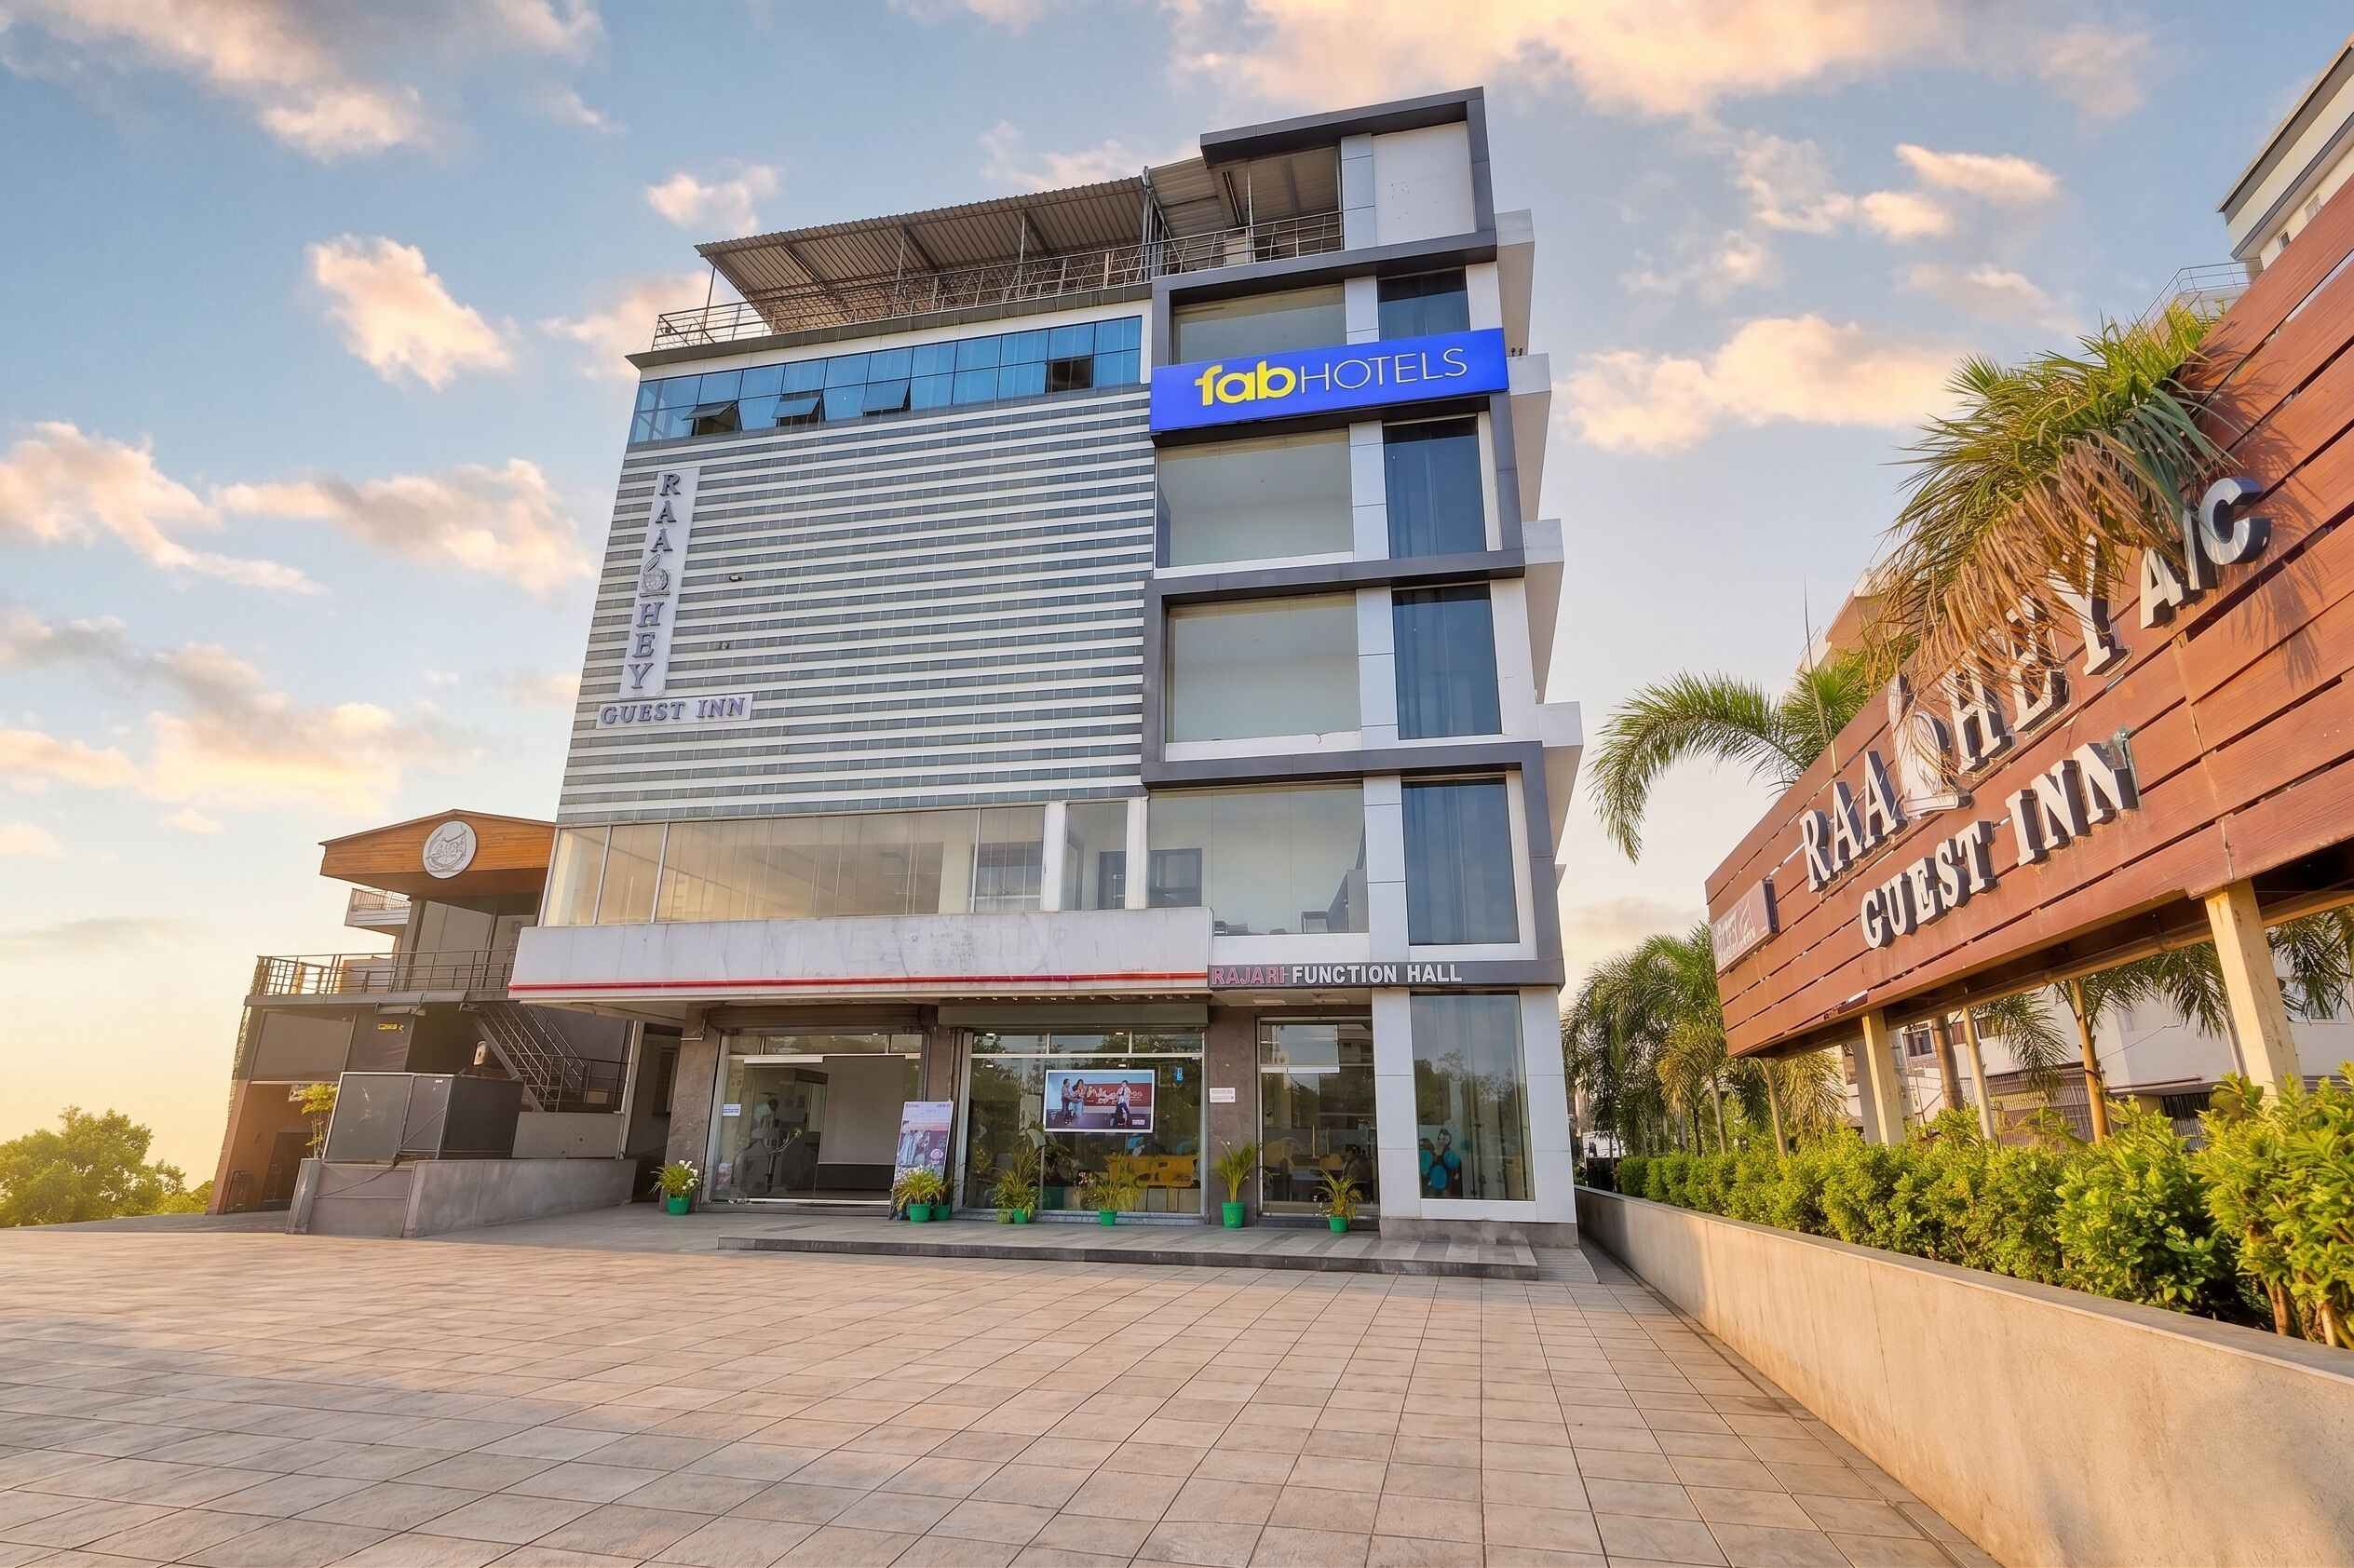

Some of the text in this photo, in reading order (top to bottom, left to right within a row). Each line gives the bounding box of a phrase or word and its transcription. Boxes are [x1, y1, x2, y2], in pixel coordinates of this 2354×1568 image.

[600, 697, 746, 725] GUEST INN
[1860, 821, 1998, 950] GUEST
[2006, 742, 2140, 867] INN
[1292, 964, 1397, 984] FUNCTION
[1406, 964, 1462, 982] HALL
